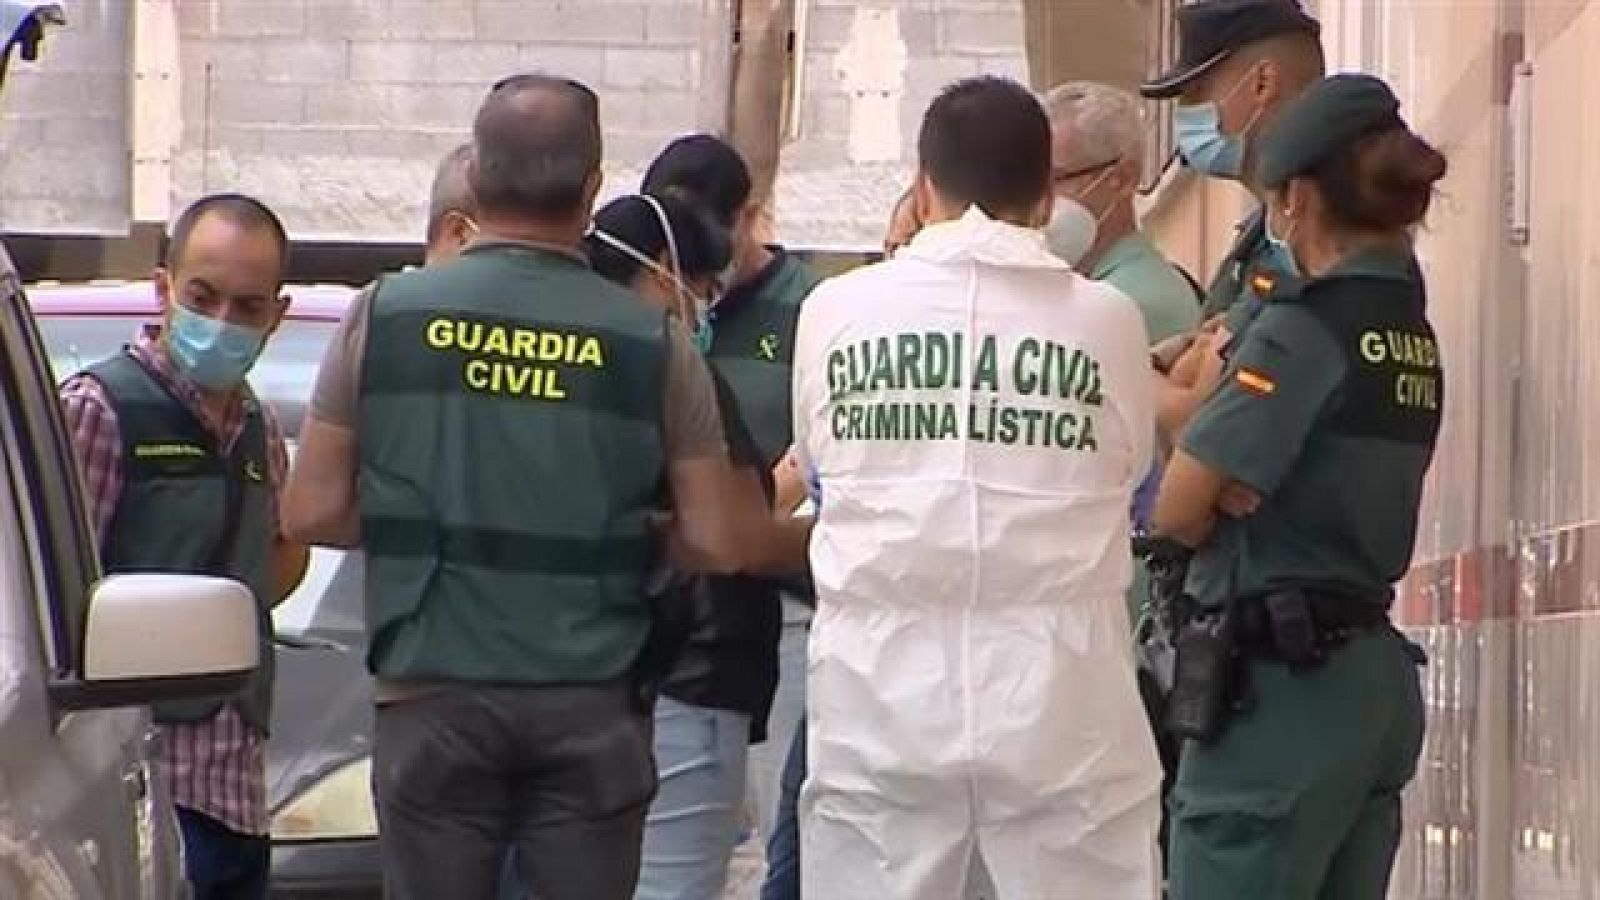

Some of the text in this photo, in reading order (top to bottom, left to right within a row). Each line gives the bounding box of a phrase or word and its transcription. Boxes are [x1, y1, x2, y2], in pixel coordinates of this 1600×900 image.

[427, 319, 603, 366] GUARDIA
[1360, 330, 1436, 368] GUARD
[466, 360, 566, 399] CIVIL
[1014, 337, 1103, 405] CIVIL
